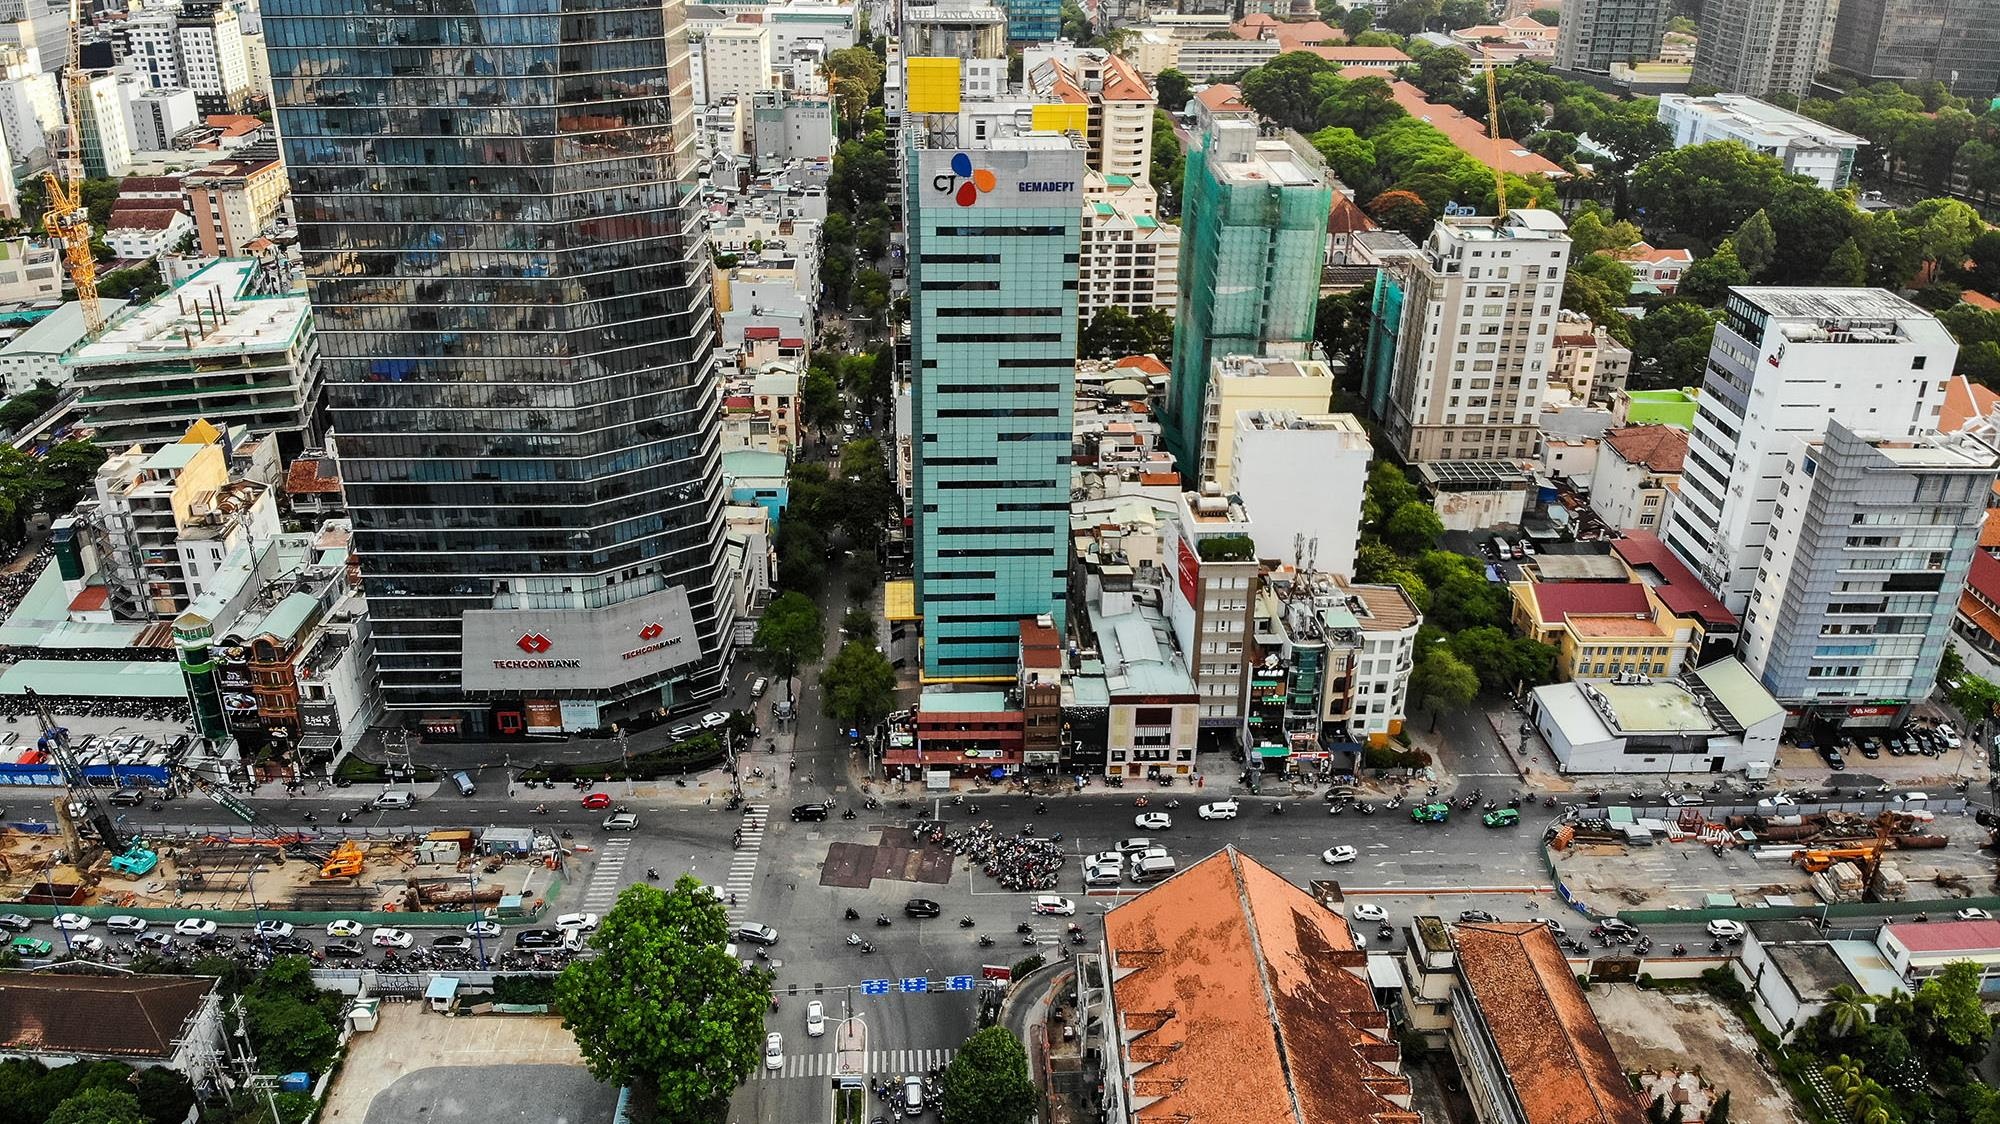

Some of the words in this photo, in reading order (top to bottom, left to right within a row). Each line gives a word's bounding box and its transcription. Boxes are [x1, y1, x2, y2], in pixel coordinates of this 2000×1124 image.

[933, 174, 957, 195] CJ
[1018, 181, 1074, 192] GEMADEPT
[621, 637, 682, 660] TECHCOMBANK
[493, 659, 581, 669] TECHCOMBANK
